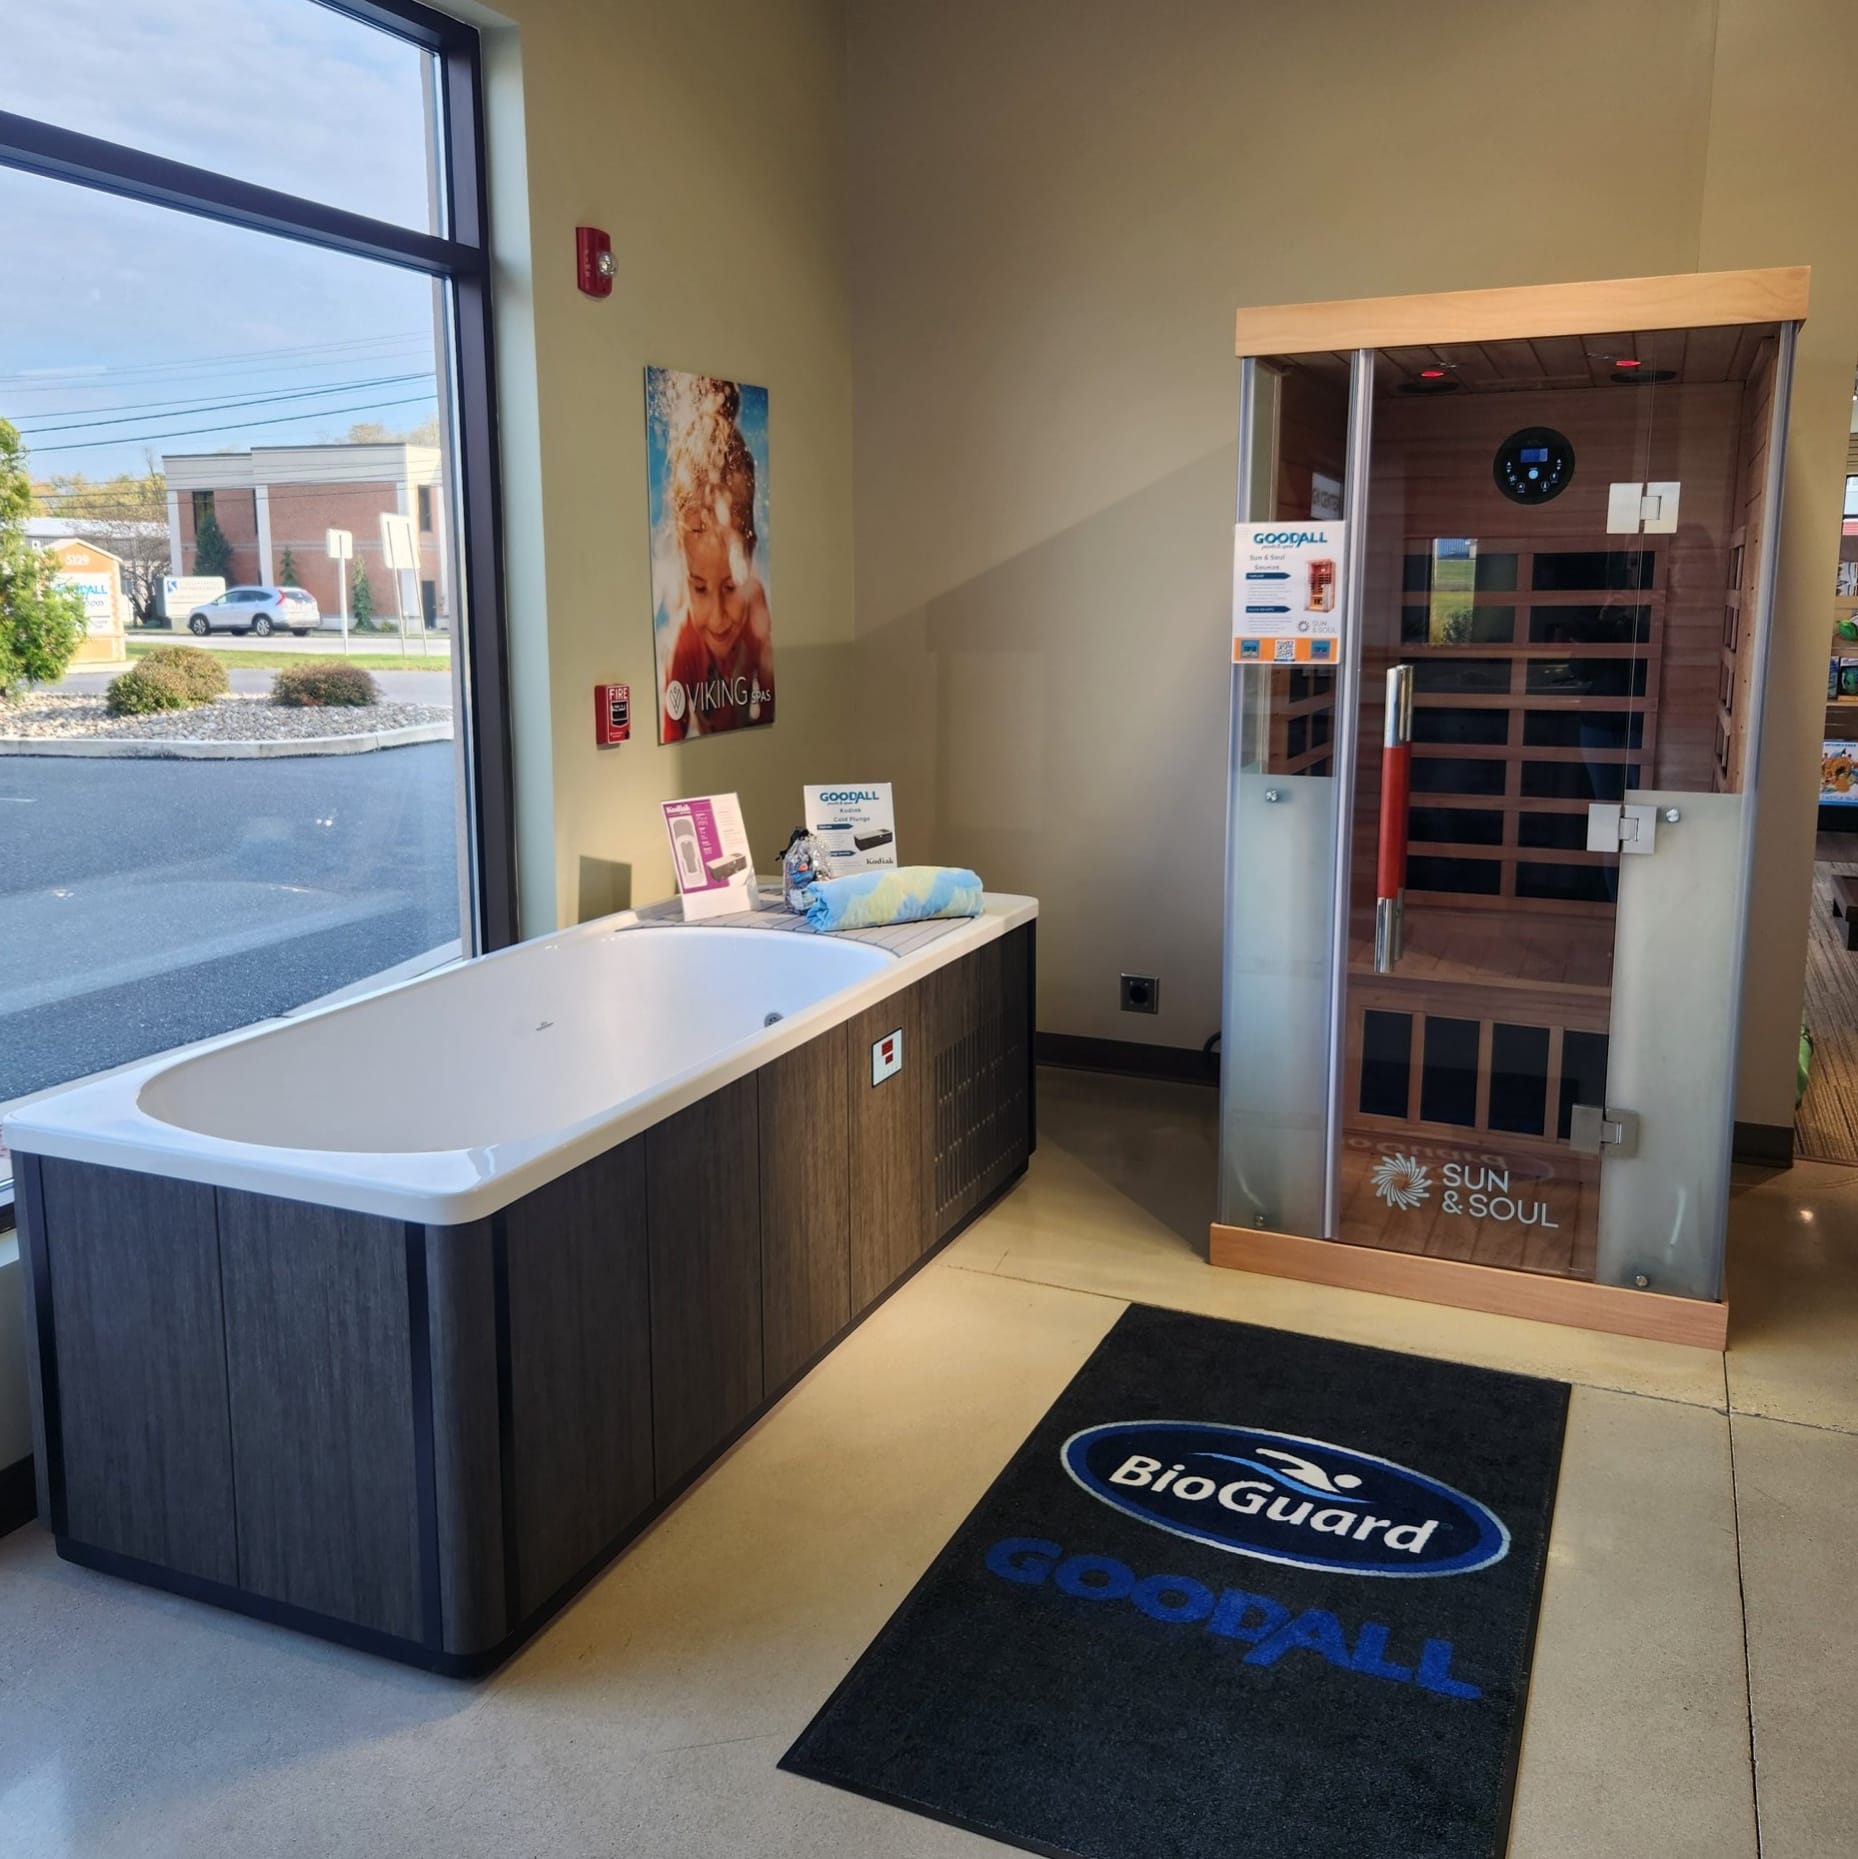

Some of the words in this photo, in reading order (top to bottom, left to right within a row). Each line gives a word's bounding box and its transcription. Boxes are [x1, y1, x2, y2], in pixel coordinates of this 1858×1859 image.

[1253, 532, 1328, 548] GOODALL
[609, 687, 628, 700] FIRE
[686, 676, 748, 712] VIKING
[751, 688, 772, 704] SPAS
[820, 791, 879, 804] GOODALL
[1442, 1163, 1509, 1193] SUN
[1442, 1190, 1464, 1215] &
[1468, 1193, 1560, 1228] SOUL
[1108, 1453, 1440, 1555] BioGuard
[984, 1536, 1483, 1699] GOODALL
